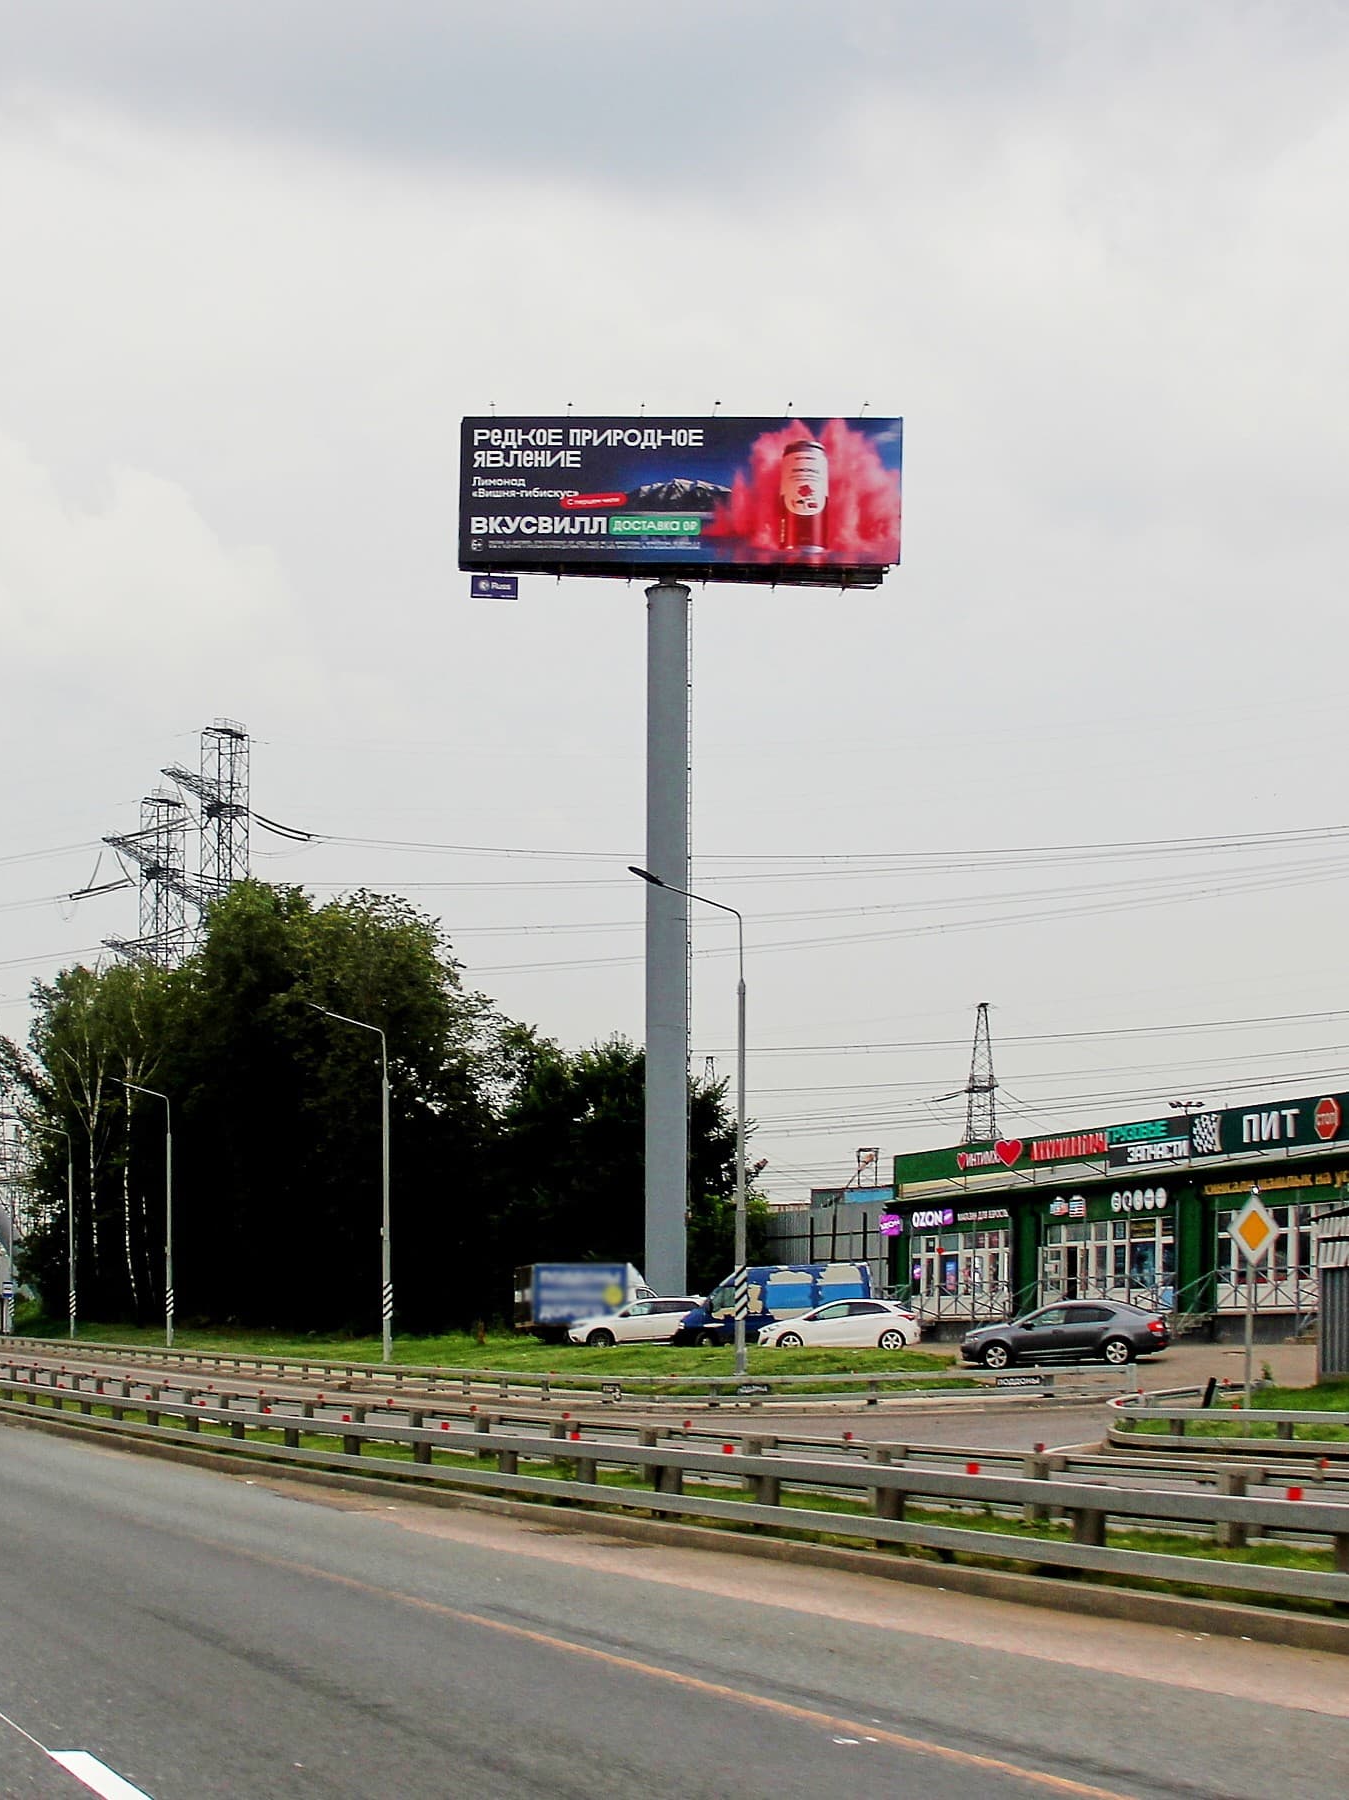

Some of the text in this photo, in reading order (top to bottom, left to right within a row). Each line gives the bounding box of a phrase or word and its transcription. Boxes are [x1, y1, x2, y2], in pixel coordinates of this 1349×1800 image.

[569, 428, 704, 450] ПРИРОДНОЕ
[472, 477, 526, 487] Лимонад
[470, 516, 608, 534] ВКУСВИЛЛ
[1242, 1108, 1300, 1143] ПИТ
[1126, 1139, 1190, 1163] ЗАПЧАСТИ
[911, 1209, 944, 1228] OZON
